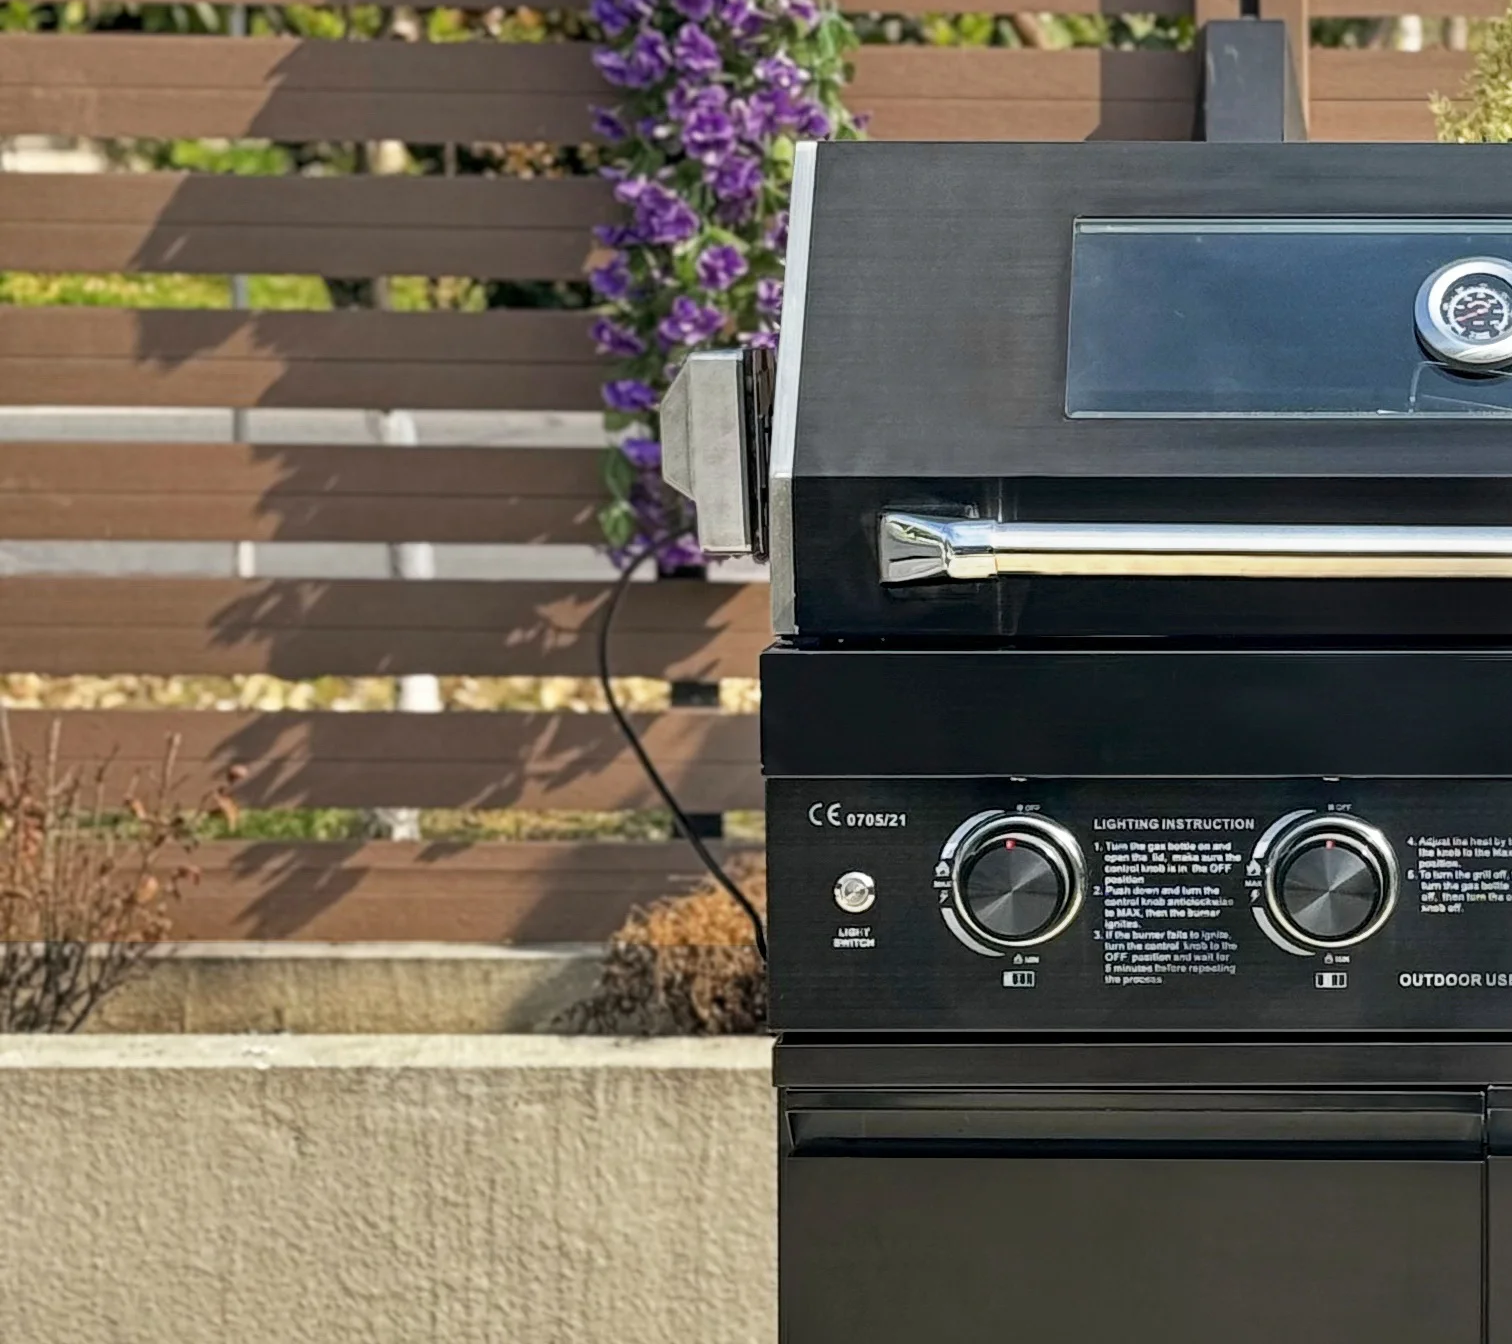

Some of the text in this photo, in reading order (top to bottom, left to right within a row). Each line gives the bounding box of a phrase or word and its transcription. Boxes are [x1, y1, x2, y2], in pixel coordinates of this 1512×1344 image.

[809, 802, 906, 827] CE 0705/21
[1094, 818, 1254, 830] LIGHTING INSTRUCTION
[1210, 863, 1232, 873] OFF
[1105, 886, 1130, 896] Push
[838, 927, 870, 937] LIGHT
[833, 938, 875, 948] SWITCH
[1104, 953, 1127, 963] OFF
[1399, 973, 1482, 987] OUTDOOR
